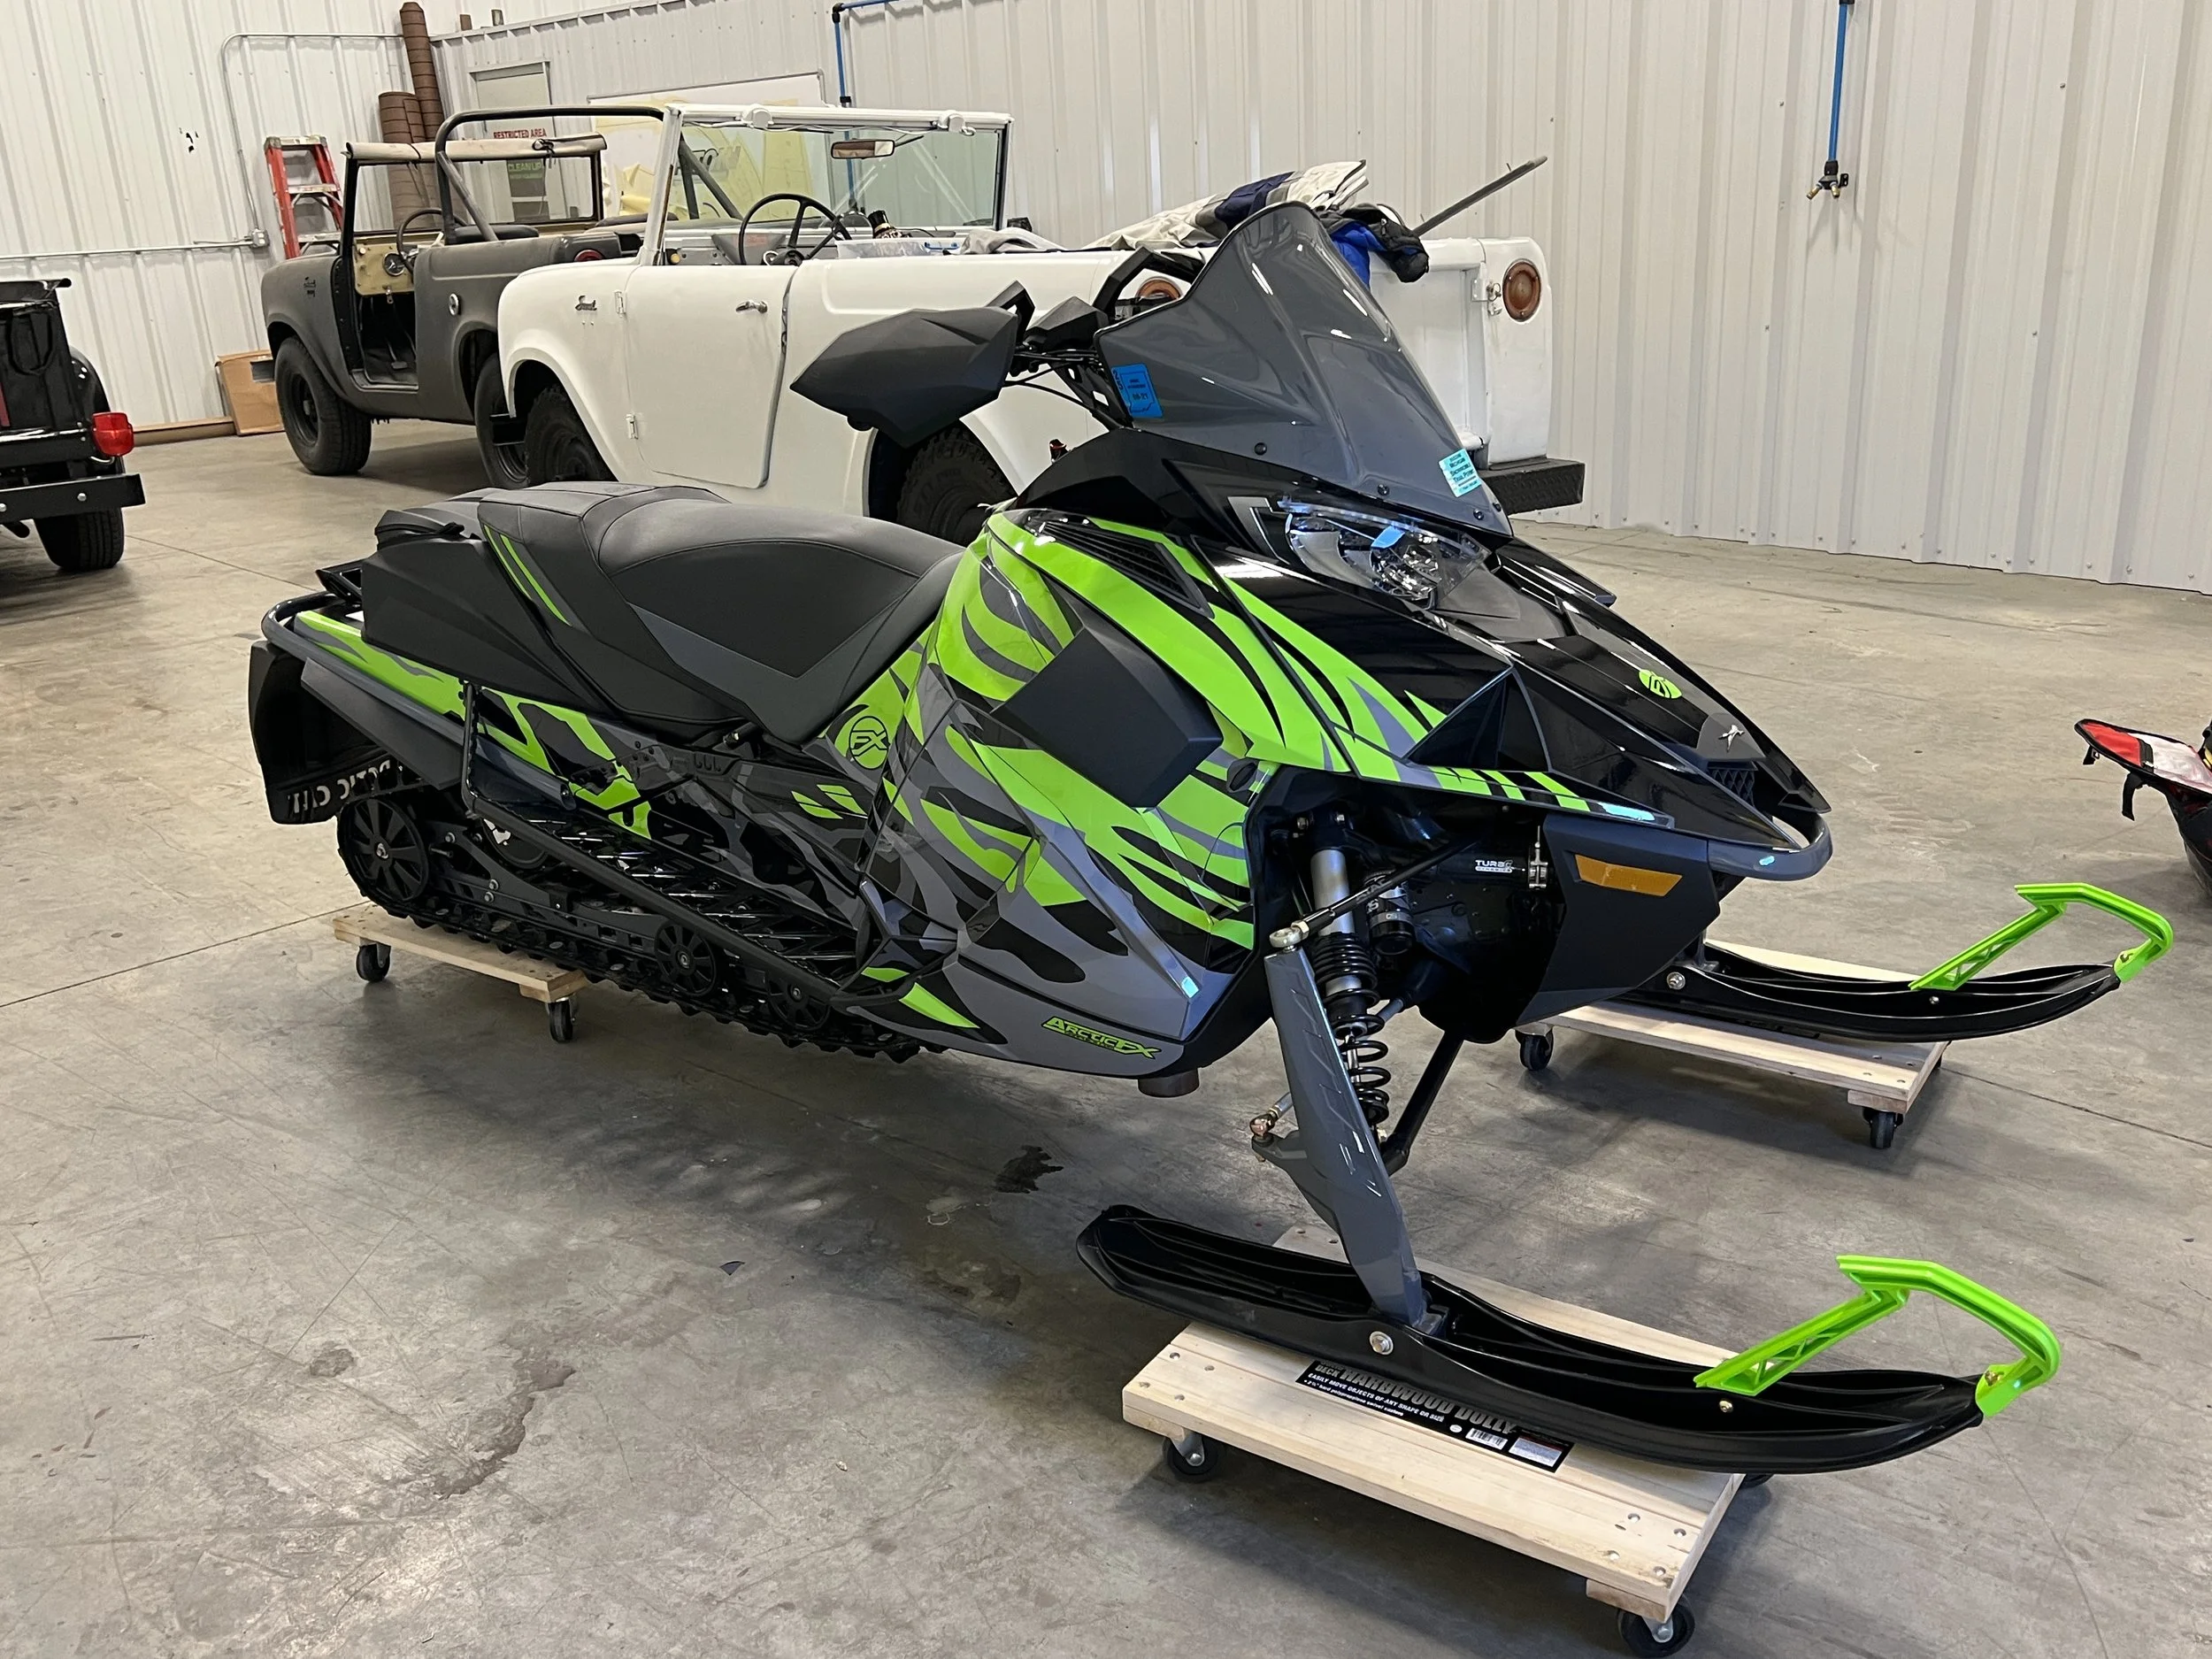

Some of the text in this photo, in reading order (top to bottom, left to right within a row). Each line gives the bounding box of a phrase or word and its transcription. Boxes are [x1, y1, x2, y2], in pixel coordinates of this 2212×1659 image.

[493, 128, 548, 139] RESTRICTED AREA
[508, 163, 532, 172] CLEAN
[1315, 1364, 1340, 1378] DECK
[1308, 1372, 1330, 1383] EASILY
[1329, 1379, 1348, 1390] MOVE
[1348, 1386, 1375, 1399] OBJECTS
[1383, 1398, 1399, 1407] ANY
[1398, 1403, 1420, 1415] SHAPE
[1429, 1414, 1445, 1423] SIZE
[1340, 1369, 1517, 1434] HARDWOOD DOLLY
